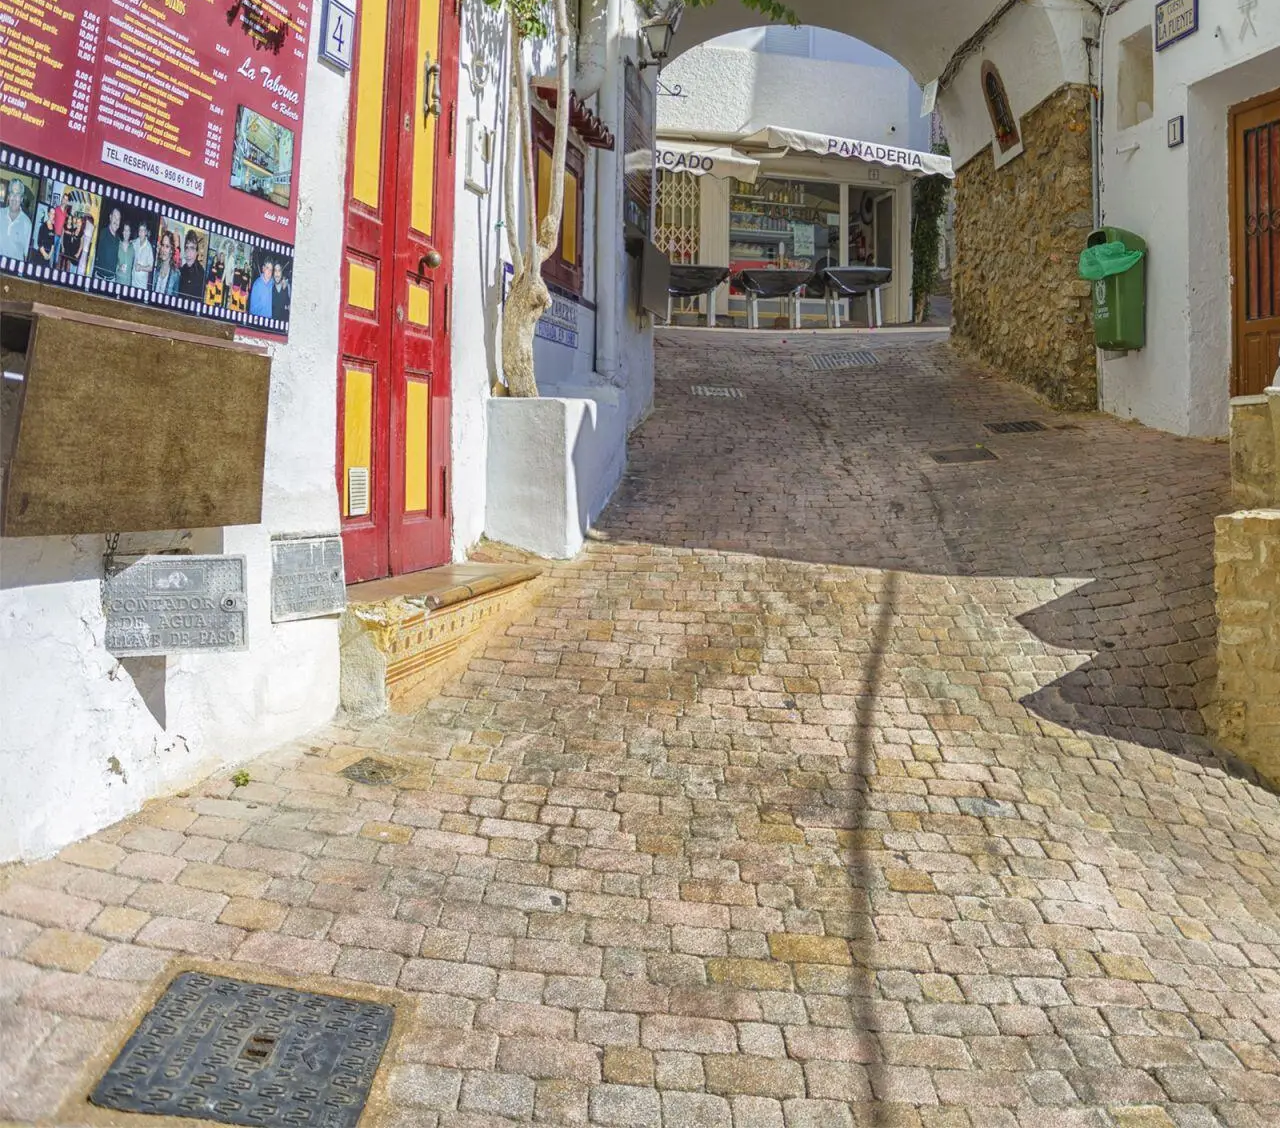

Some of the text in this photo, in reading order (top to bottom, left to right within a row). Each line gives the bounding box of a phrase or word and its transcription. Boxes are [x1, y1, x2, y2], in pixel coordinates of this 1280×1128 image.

[333, 15, 344, 53] 4
[1169, 8, 1193, 37] FUENTE
[237, 56, 300, 105] La Taberna
[106, 147, 120, 161] TEL.
[122, 153, 160, 175] RESERVAS
[164, 169, 175, 182] 950
[176, 173, 184, 185] 61
[185, 176, 193, 188] 51
[194, 180, 202, 191] 06
[110, 597, 216, 613] CONTADOR
[120, 613, 208, 630] DE AGUA
[112, 630, 237, 648] LLAVE DE PASO
